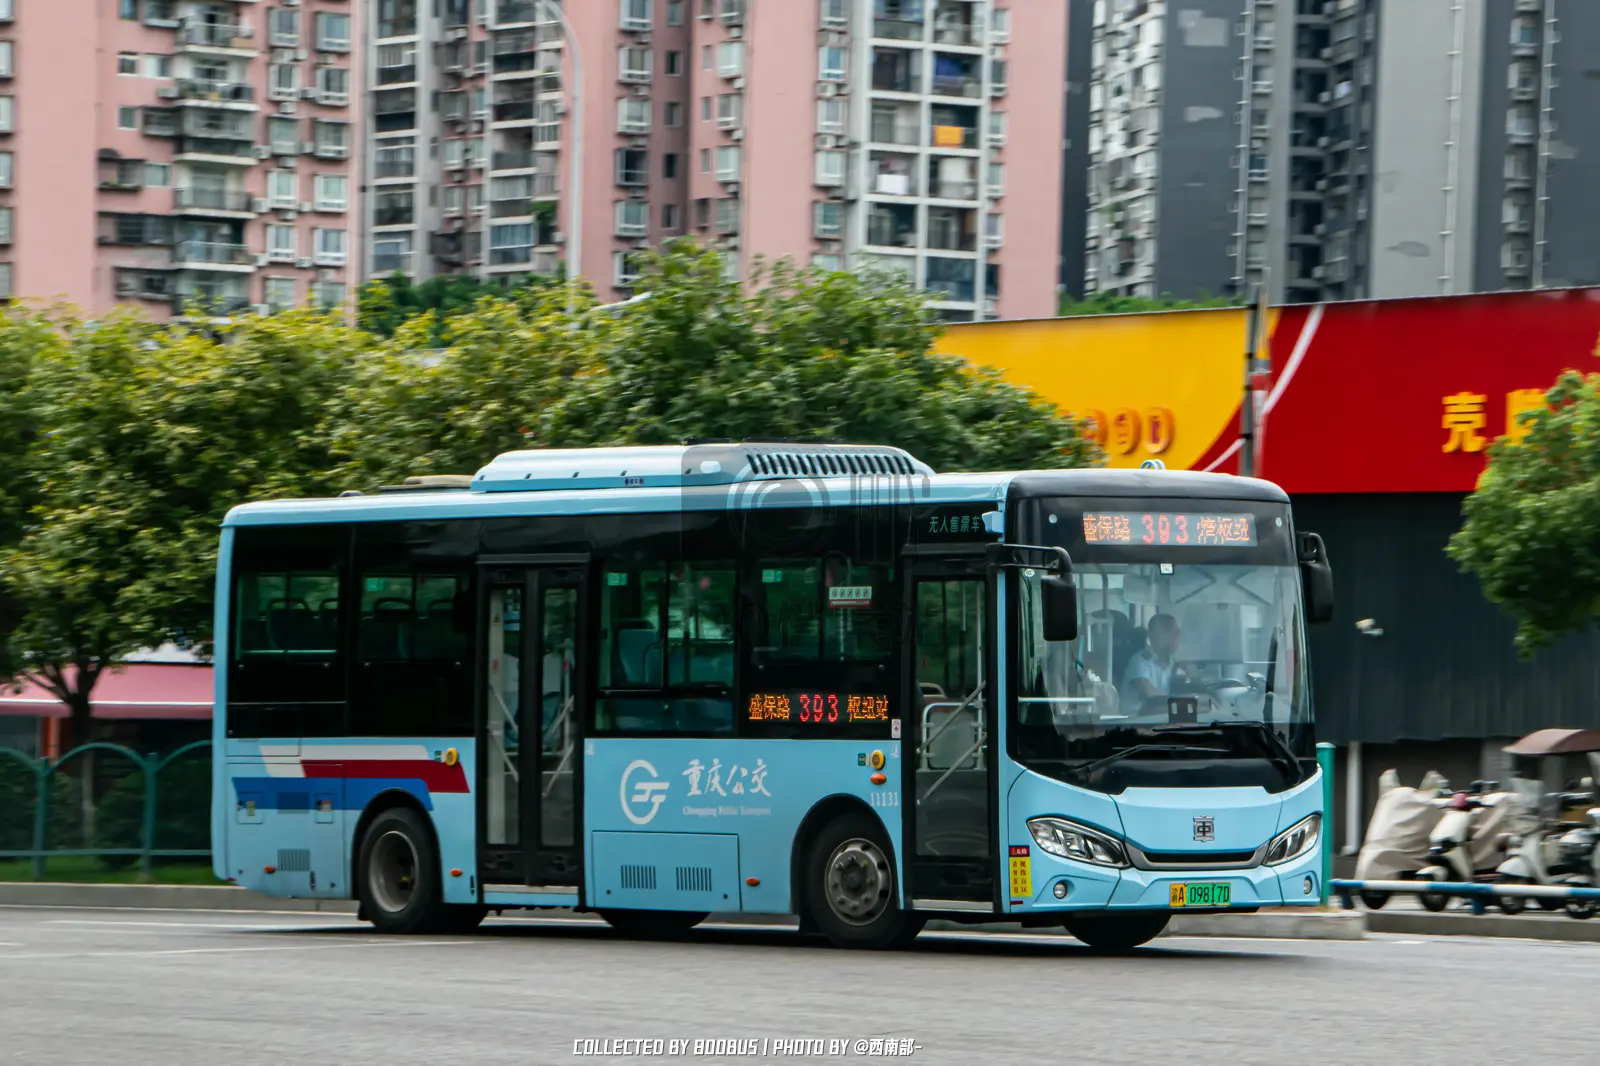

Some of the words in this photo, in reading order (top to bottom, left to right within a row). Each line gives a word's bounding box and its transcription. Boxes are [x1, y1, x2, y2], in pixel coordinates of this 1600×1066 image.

[929, 516, 981, 533] 无人售票车
[1142, 513, 1189, 544] 393
[749, 694, 791, 720] 盛保路
[800, 694, 839, 722] 393
[847, 695, 889, 722] 枢纽站
[682, 758, 772, 797] 重庆公交
[870, 792, 899, 806] 11131
